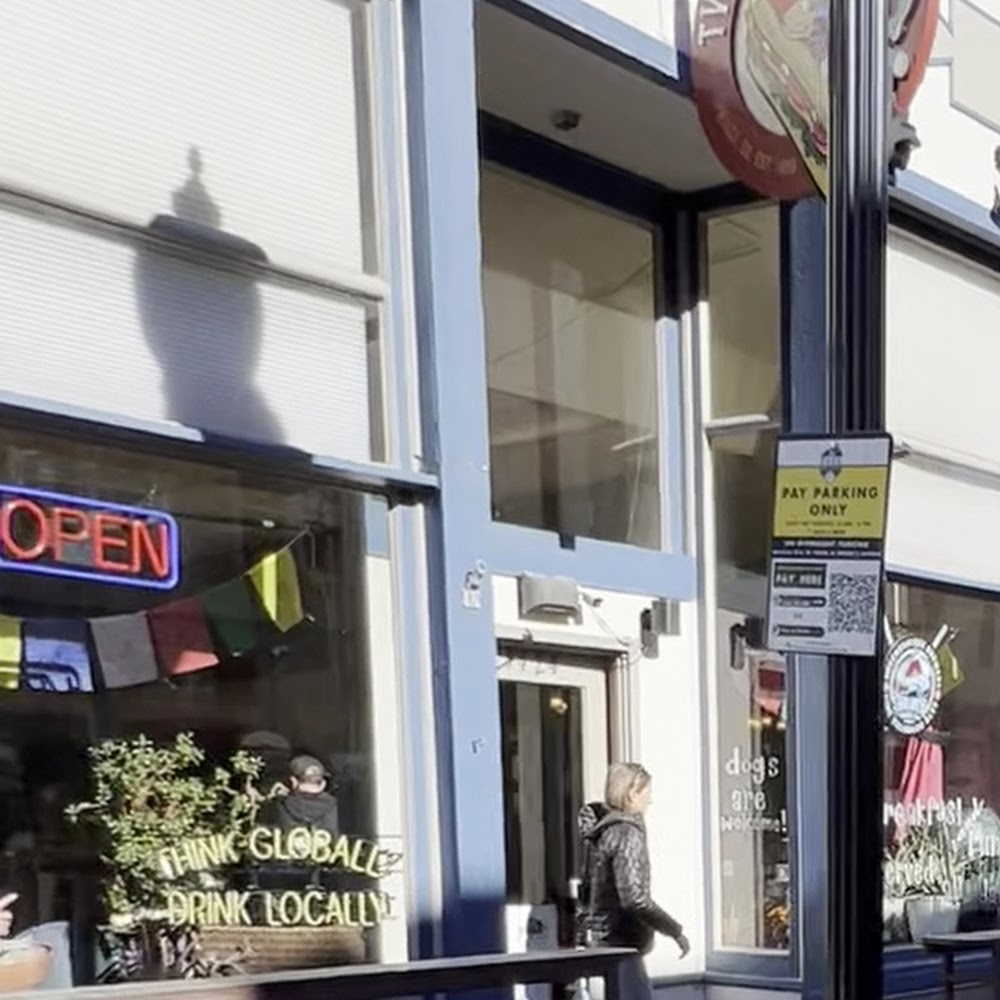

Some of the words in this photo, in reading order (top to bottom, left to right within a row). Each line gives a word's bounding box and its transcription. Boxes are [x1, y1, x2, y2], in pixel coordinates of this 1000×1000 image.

[782, 487, 807, 498] PAY
[814, 486, 878, 499] PARKING
[809, 504, 847, 516] ONLY
[1, 498, 170, 578] OPEN
[725, 746, 780, 784] dogs
[731, 789, 766, 811] are
[883, 796, 962, 826] reakfast
[157, 832, 241, 880] THINK
[167, 891, 252, 926] DRINK
[265, 890, 387, 927] LOCALLY
